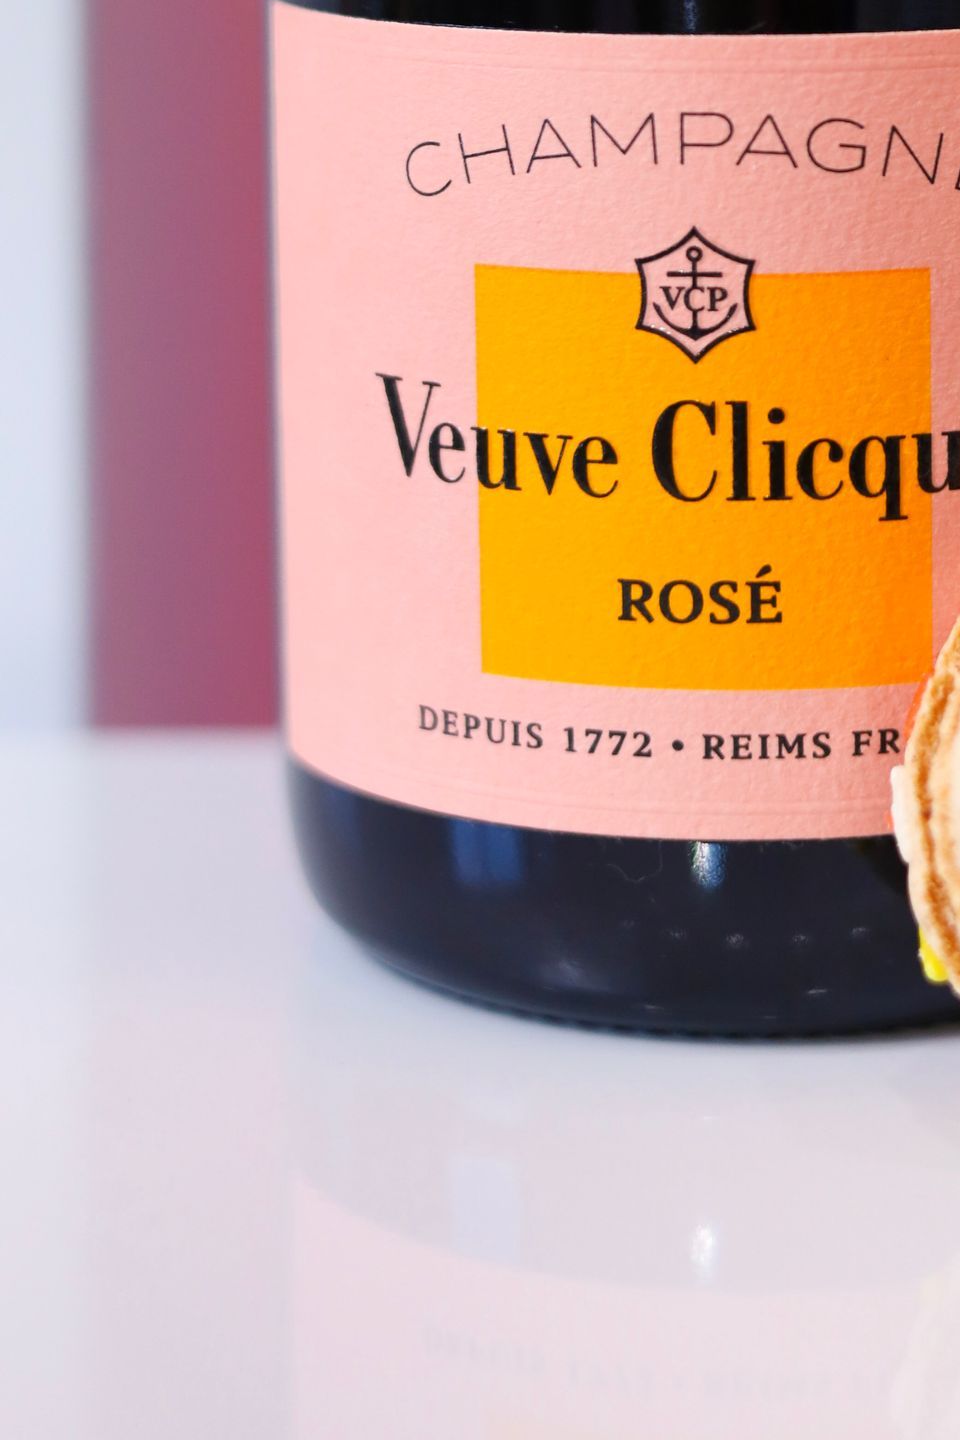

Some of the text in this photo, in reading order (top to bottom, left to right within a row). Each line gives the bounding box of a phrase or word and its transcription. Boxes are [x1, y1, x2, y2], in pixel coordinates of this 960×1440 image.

[659, 285, 728, 312] VCP
[375, 371, 619, 499] Veuve
[617, 564, 783, 626] ROSÉ
[418, 704, 544, 750] DEPUIS
[564, 726, 652, 758] 1772
[702, 731, 832, 760] REIMS
